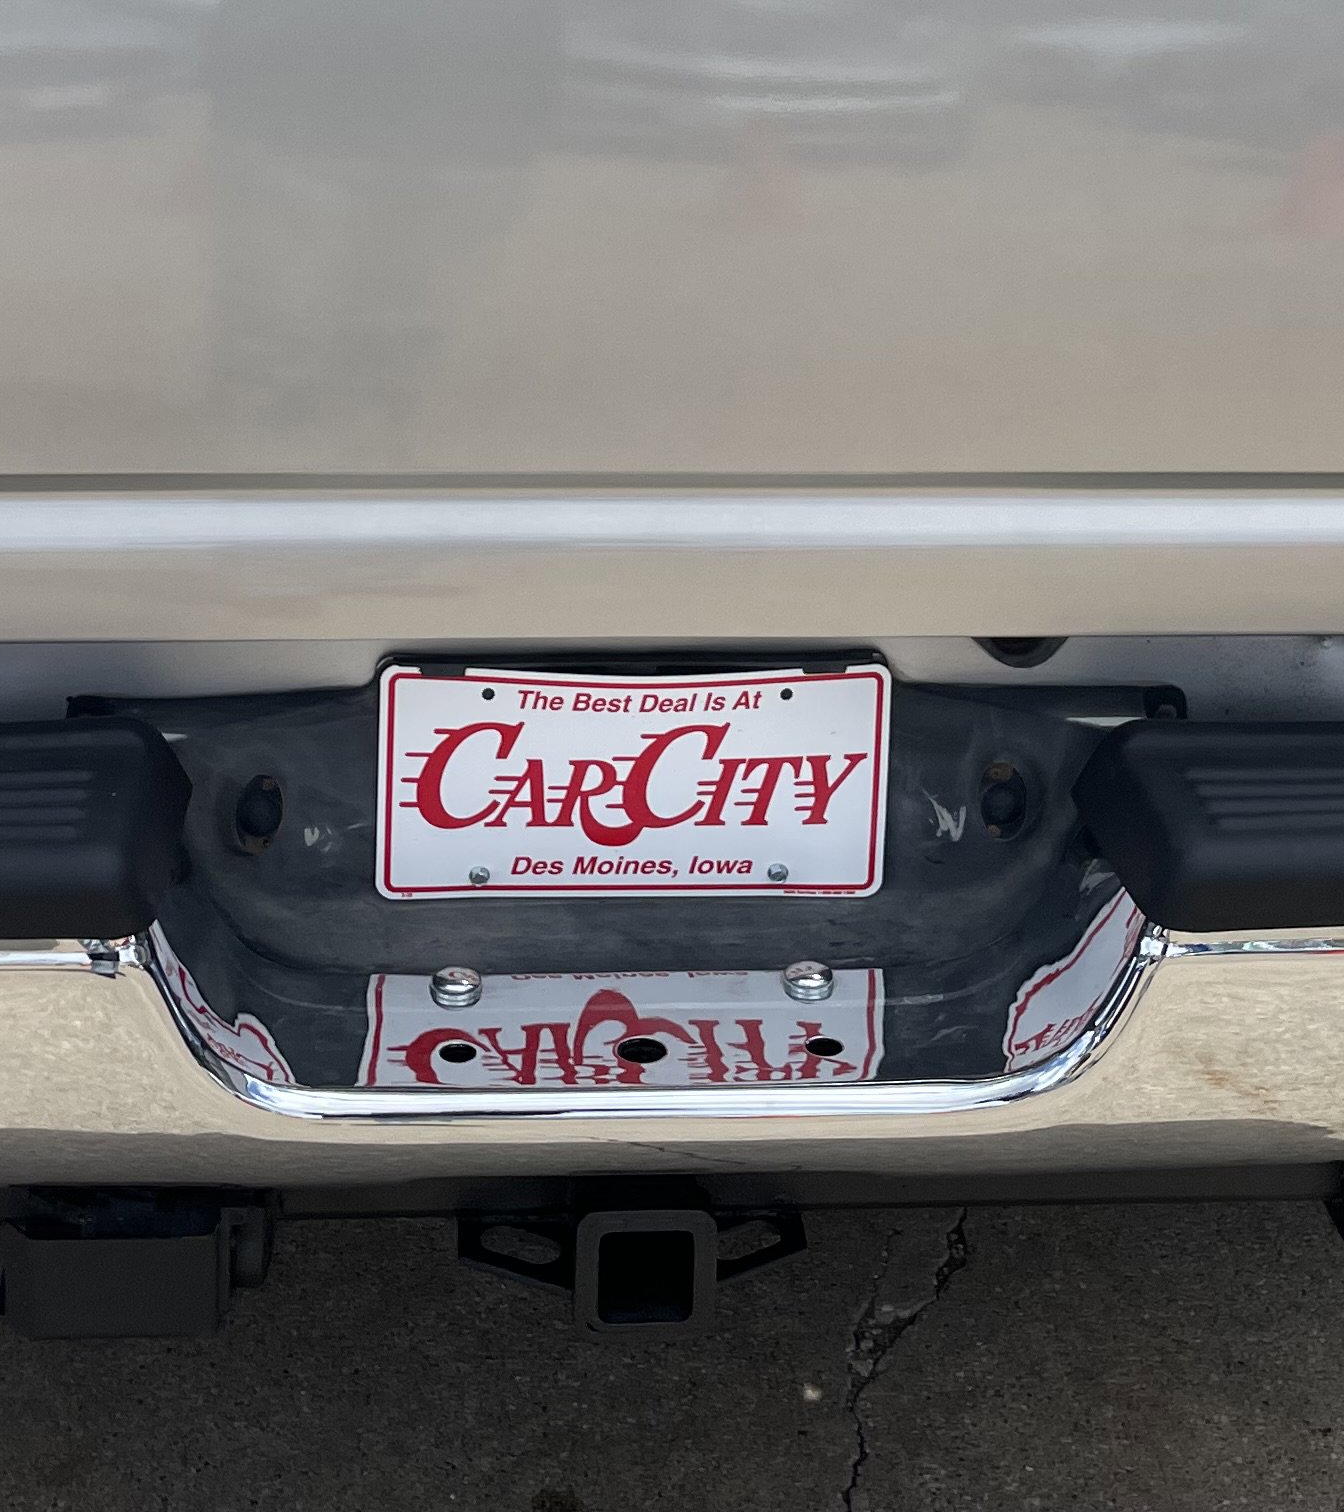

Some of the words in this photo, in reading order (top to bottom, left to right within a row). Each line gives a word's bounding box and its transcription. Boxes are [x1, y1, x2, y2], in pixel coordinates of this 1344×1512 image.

[516, 690, 564, 712] The
[571, 693, 631, 713] Best
[638, 693, 695, 713] Deal
[703, 692, 726, 712] Is
[732, 690, 762, 711] At
[510, 855, 564, 876] Des
[572, 855, 679, 879] Moines,
[689, 855, 753, 876] Iowa
